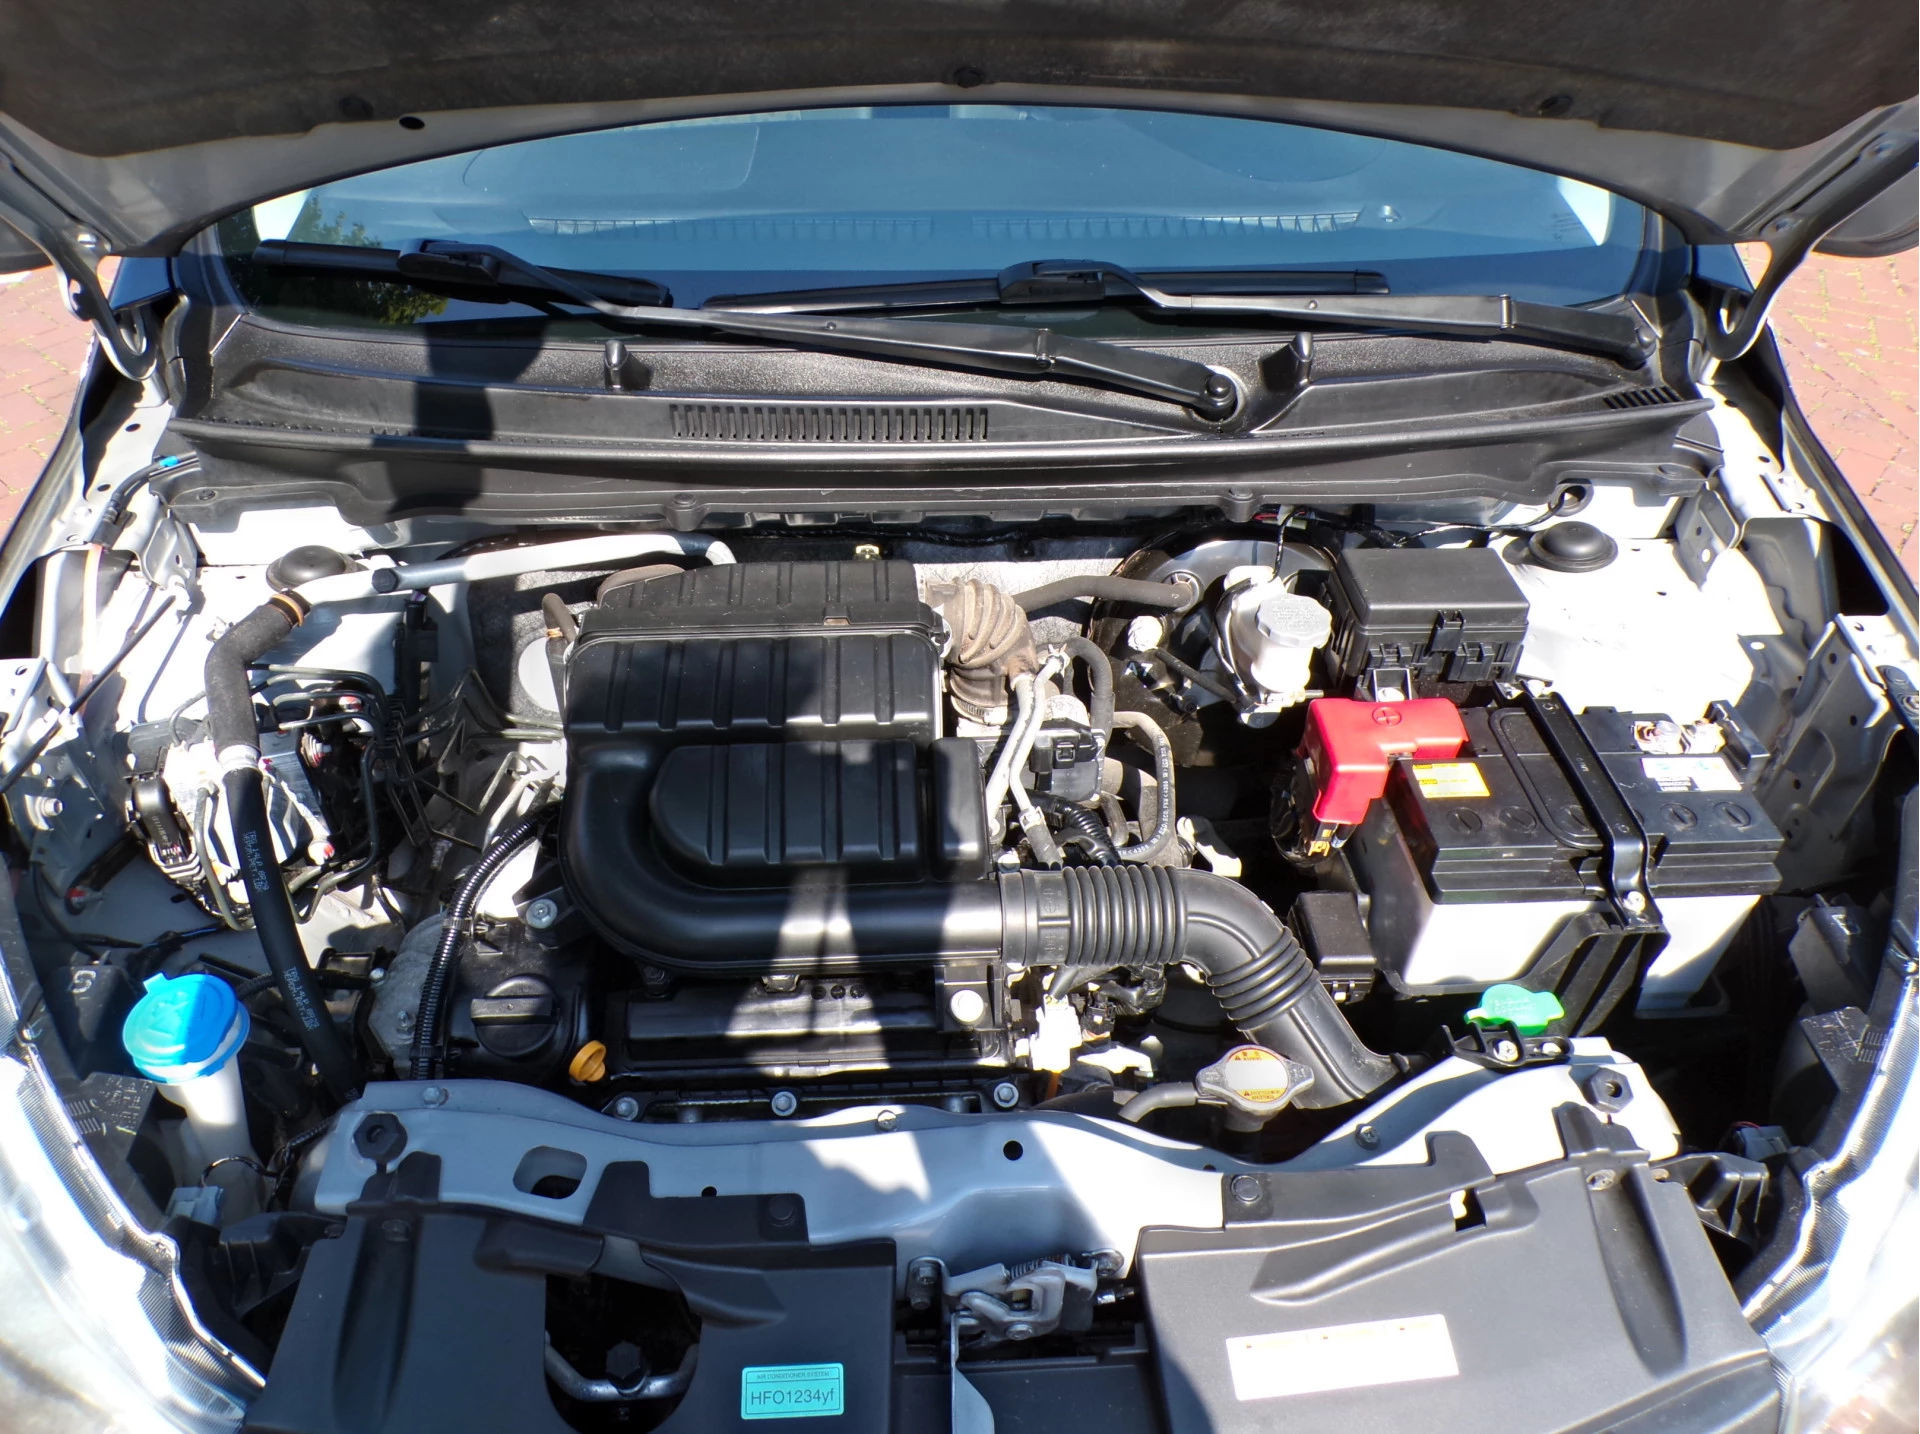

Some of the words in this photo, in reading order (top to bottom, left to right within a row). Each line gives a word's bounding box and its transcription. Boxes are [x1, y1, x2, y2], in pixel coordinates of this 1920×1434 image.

[1124, 662, 1153, 677] A7
[768, 1372, 805, 1380] CONDITIONER
[807, 1370, 830, 1378] SYSTEM
[750, 1387, 835, 1406] HFO1234yf
